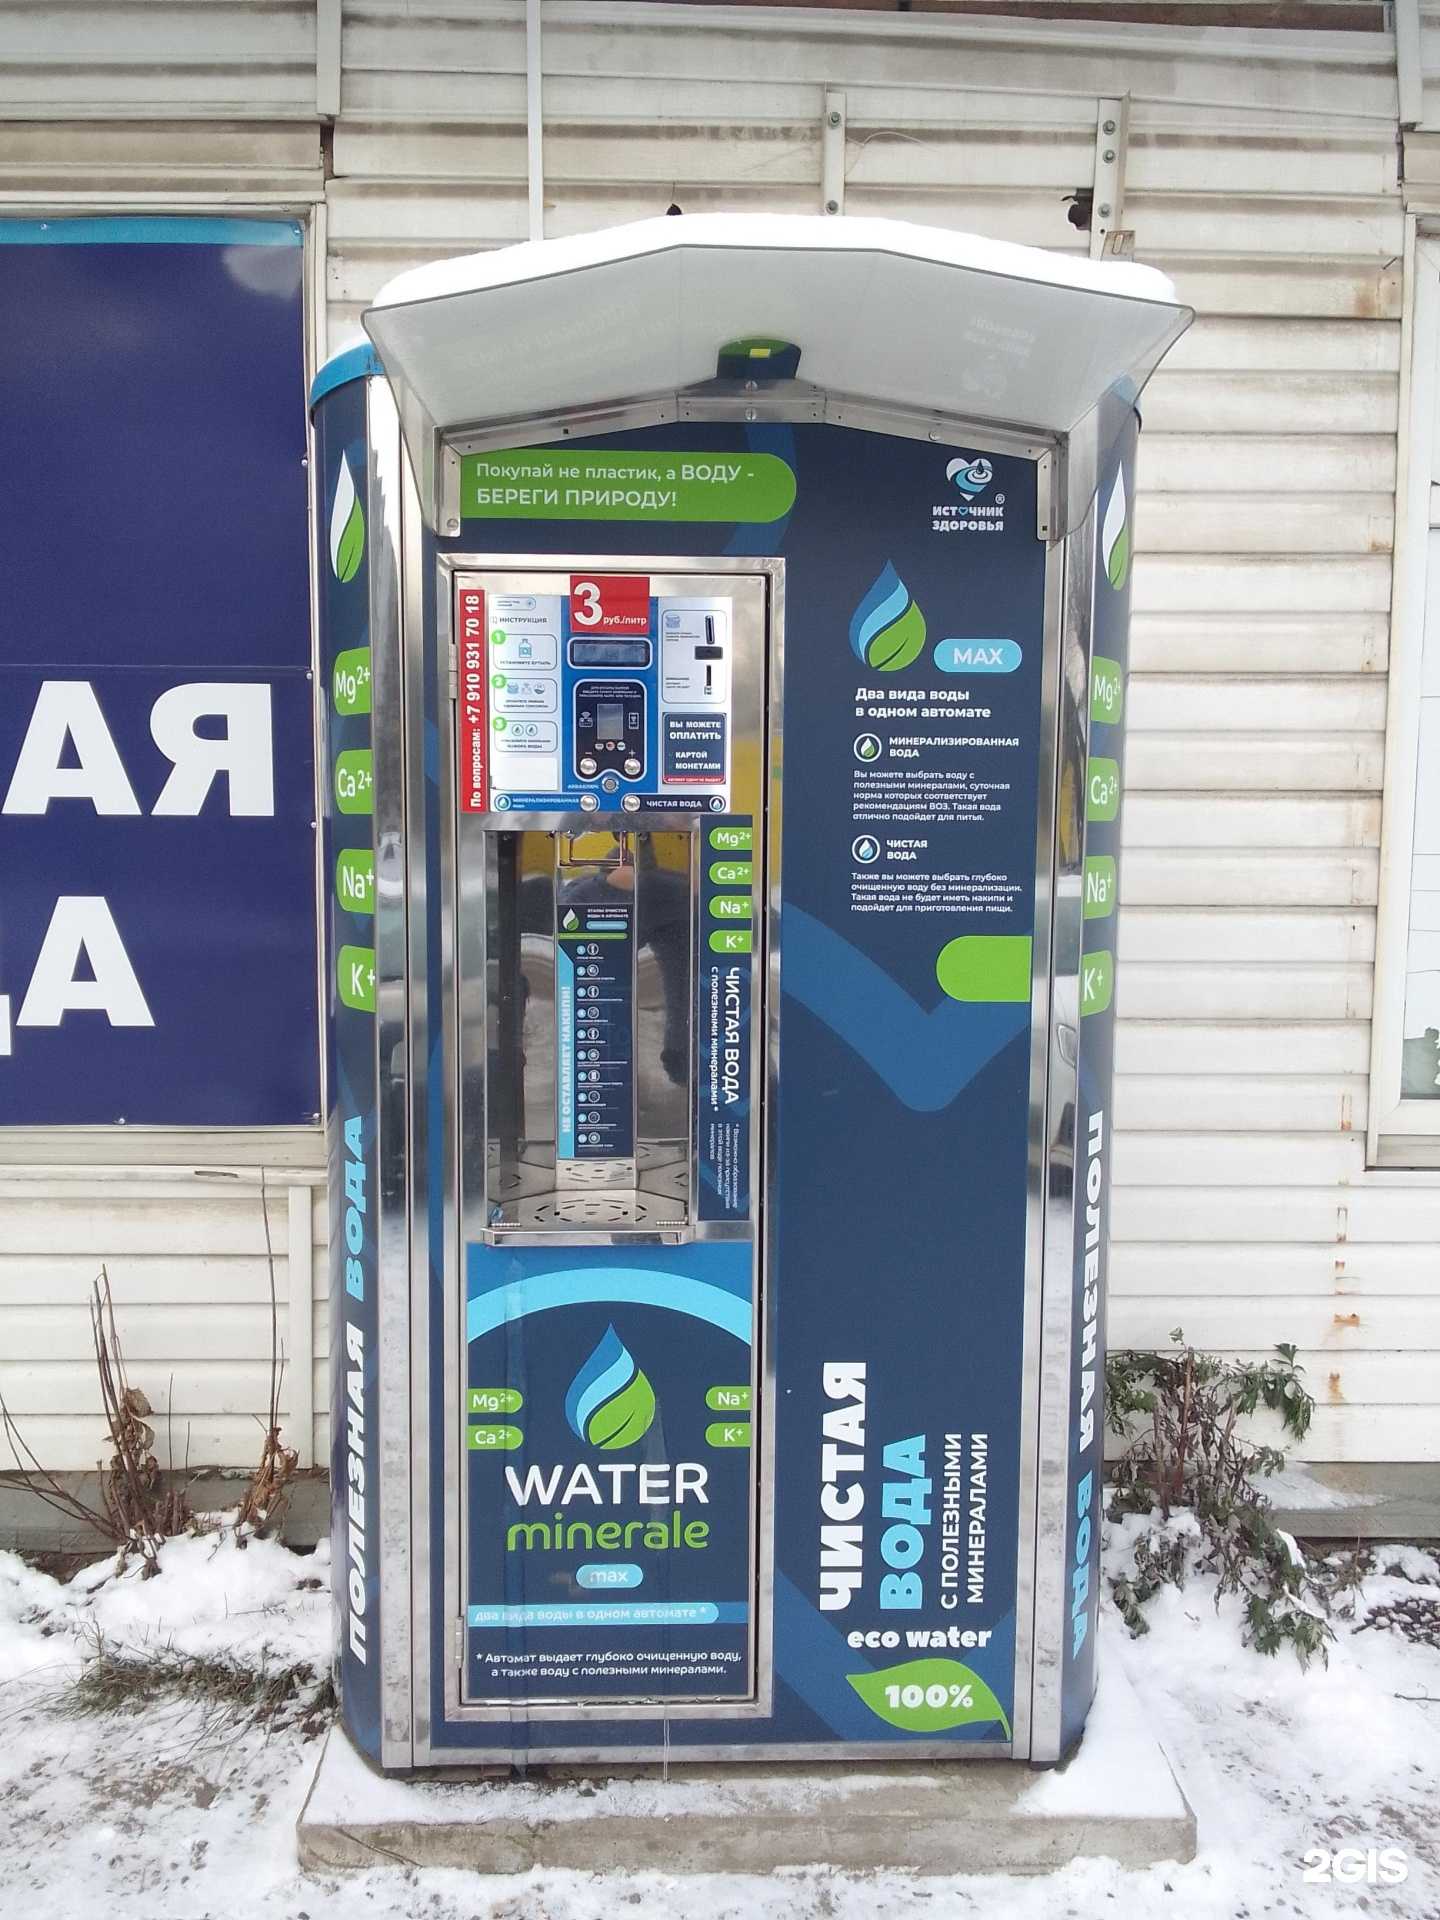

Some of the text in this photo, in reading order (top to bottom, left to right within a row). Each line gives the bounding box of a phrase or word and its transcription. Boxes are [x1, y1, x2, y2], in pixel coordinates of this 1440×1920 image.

[476, 463, 553, 480] Покупай
[559, 467, 580, 478] не
[585, 466, 661, 481] пластик,
[666, 470, 676, 480] а
[681, 465, 742, 484] ВОДУ
[477, 488, 677, 509] БЕРЕГИ ПРИРОДУ!
[932, 520, 1004, 532] ЗДОРОВЬЯ
[573, 582, 603, 626] 3
[603, 616, 647, 625] руб./литр
[953, 648, 1003, 664] MAX
[466, 595, 483, 807] По вопросам: +7 910 931 70 18
[856, 688, 969, 701] Два вида воды
[856, 708, 992, 718] в одном автомате
[670, 732, 721, 740] ОПЛАТИТЬ
[889, 737, 1019, 746] МИНЕРАЛИЗИРОВАННАЯ
[889, 749, 920, 758] ВОДА
[905, 771, 944, 780] выбрать
[946, 772, 967, 780] воду
[908, 783, 968, 791] минералами,
[969, 783, 1010, 791] суточная
[854, 793, 987, 801] норма которых соответствует
[853, 803, 927, 812] рекомендациям
[979, 804, 1001, 812] вода
[892, 813, 935, 822] подойдет
[937, 814, 954, 822] для
[887, 840, 928, 848] ЧИСТАЯ
[887, 852, 917, 861] ВОДА
[931, 872, 970, 882] выбрать
[971, 873, 1008, 883] глубоко
[851, 883, 1022, 893] очищенную воду без минерализации.
[851, 893, 876, 901] Такая
[878, 894, 900, 902] вода
[915, 894, 940, 903] будет
[851, 903, 894, 912] подойдет
[915, 905, 983, 913] приготовления
[985, 905, 1013, 913] пищи.
[0, 896, 156, 1055] А
[711, 975, 719, 1036] полезными
[722, 967, 740, 1105] ЧИСТАЯ ВОДА
[344, 1115, 366, 1665] ПОЛЕЗНАЯ ВОДА
[1072, 1109, 1103, 1660] ПОЛЕЗНАЯ ВОДА
[504, 1462, 710, 1506] WATER
[819, 1362, 867, 1611] ЧИСТАЯ
[879, 1434, 932, 1610] ВОДА
[940, 1433, 962, 1610] С ПОЛЕЗНЫМИ
[966, 1433, 988, 1604] МИНЕРАЛАМИ
[507, 1510, 710, 1552] minerale
[590, 1568, 628, 1583] max
[475, 1612, 498, 1622] два
[537, 1611, 572, 1621] воды
[575, 1610, 584, 1619] в
[587, 1609, 629, 1620] одном
[633, 1608, 697, 1619] автомате
[847, 1626, 992, 1648] eco water
[485, 1651, 742, 1664] Автомат выдает глубоко очищенную воду,
[491, 1665, 727, 1679] а также воду с полезными минералами.
[885, 1684, 974, 1708] 100%
